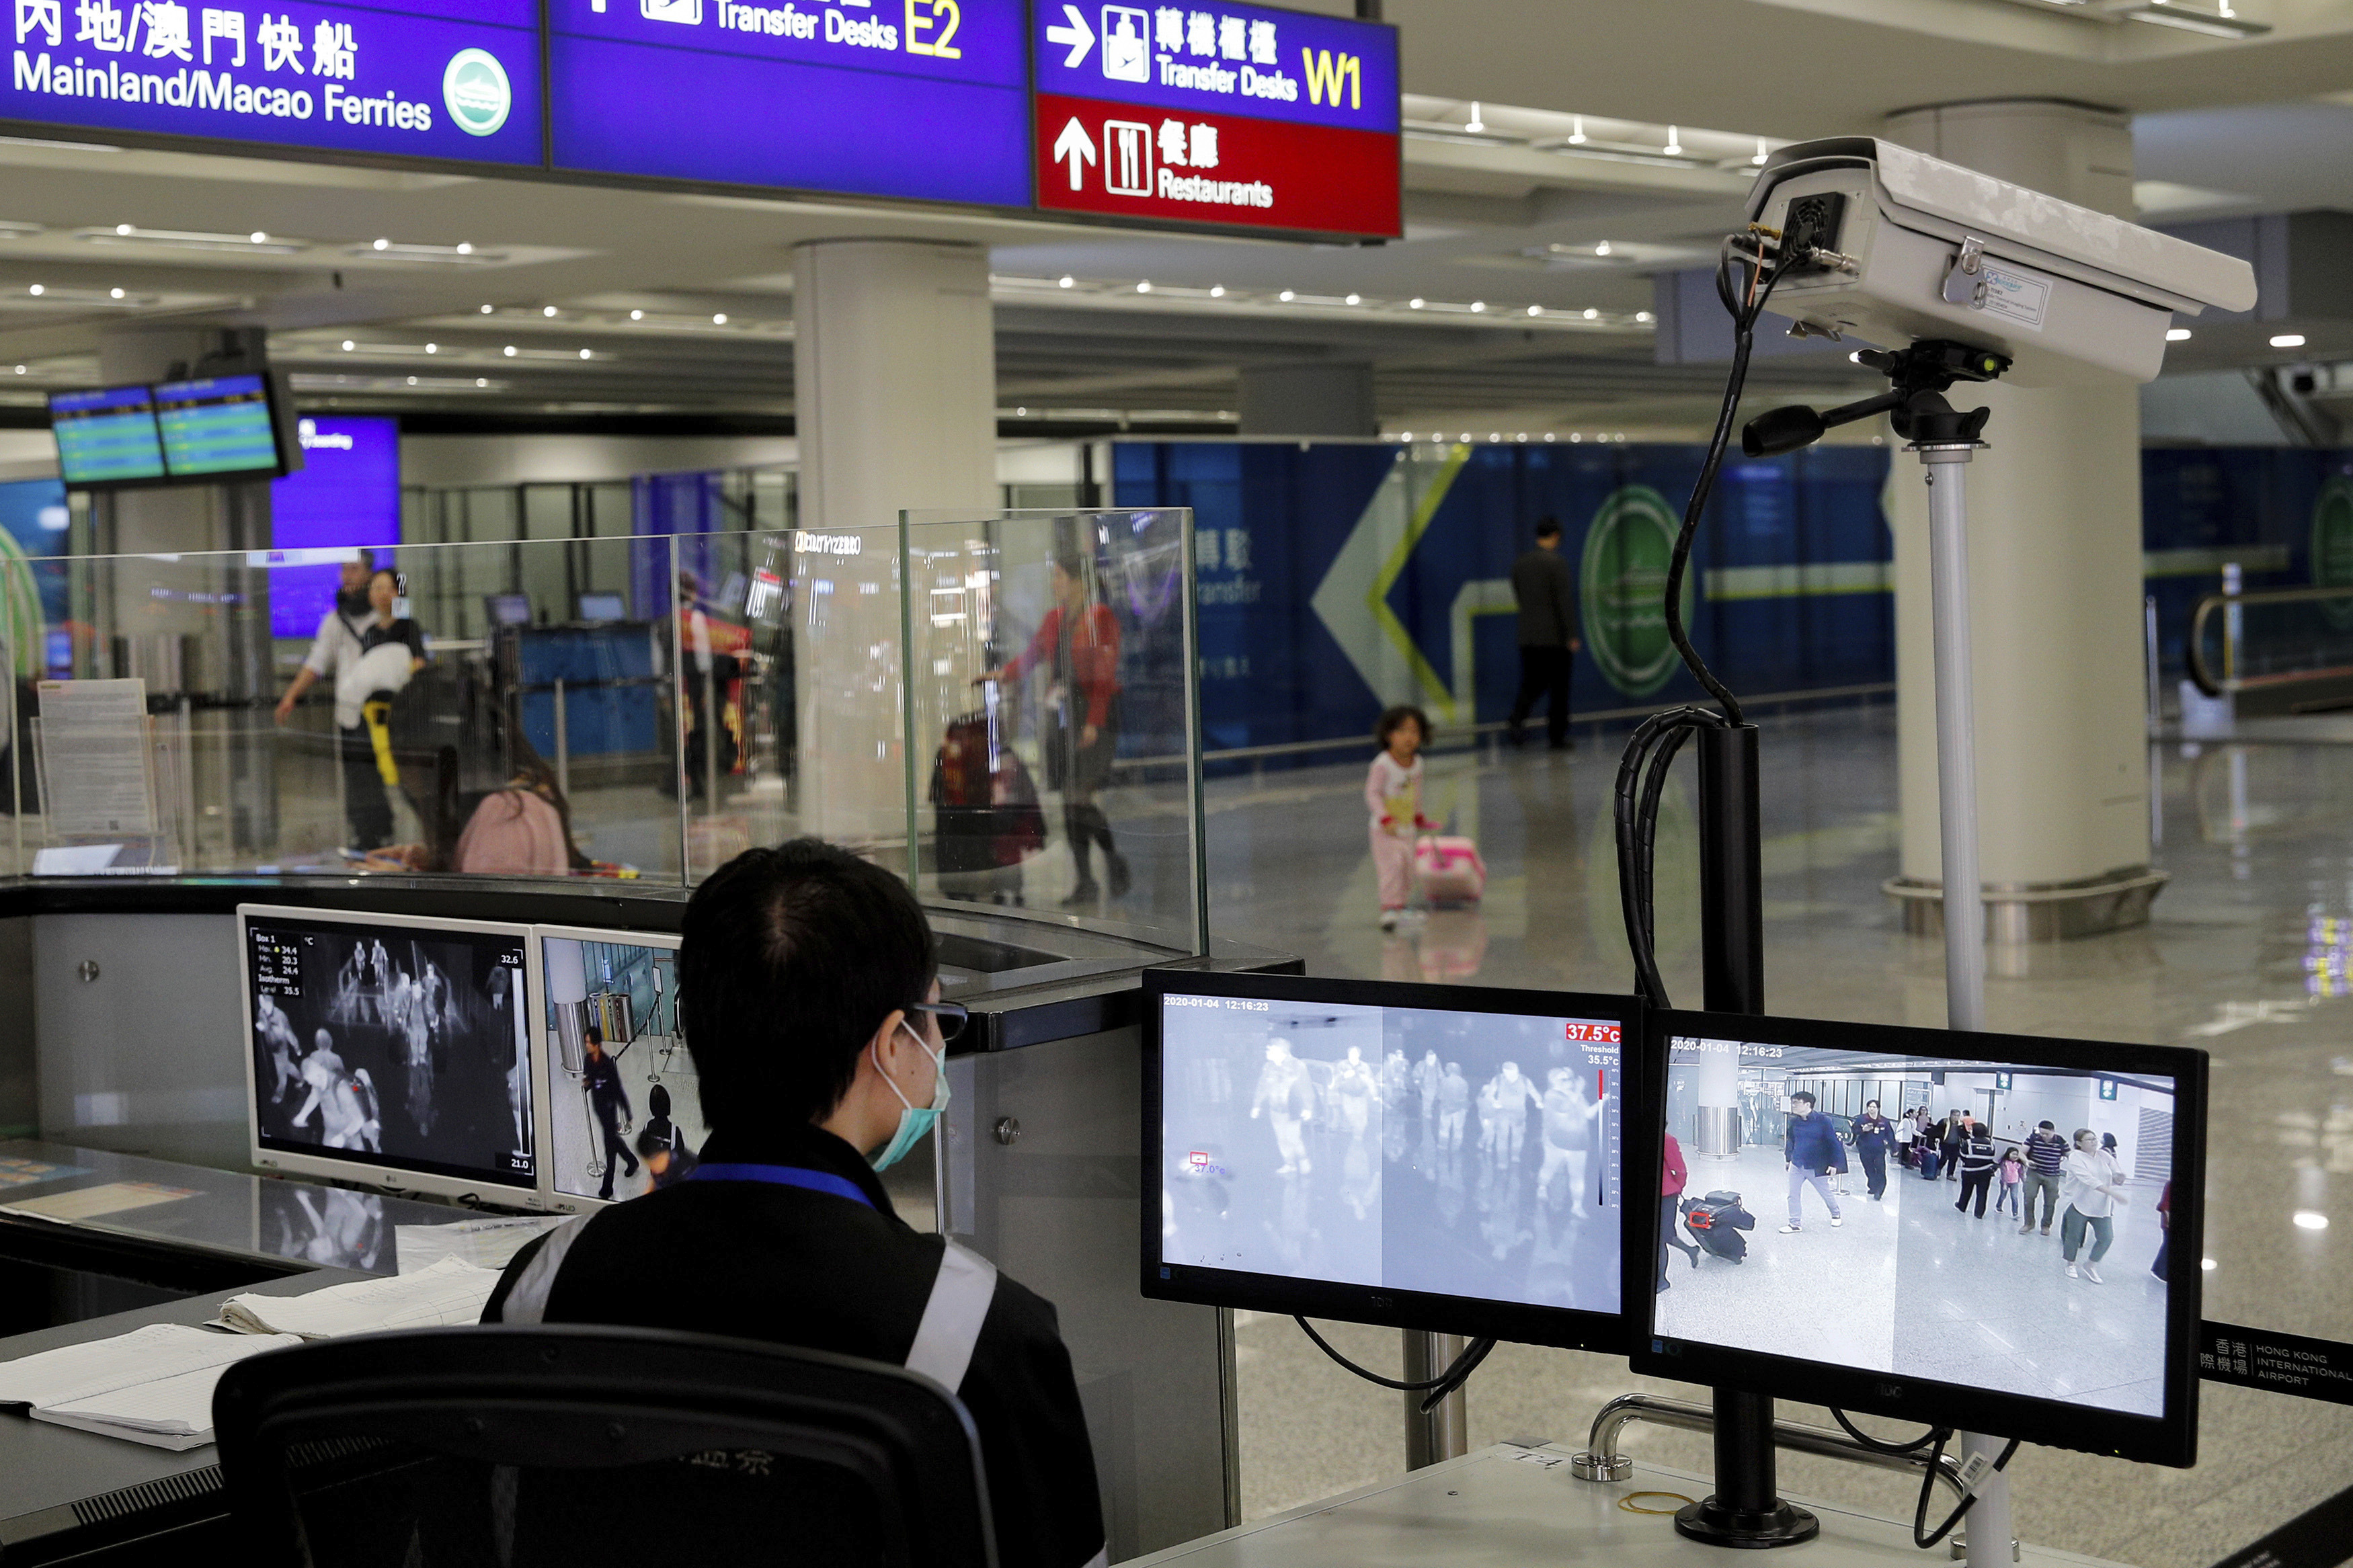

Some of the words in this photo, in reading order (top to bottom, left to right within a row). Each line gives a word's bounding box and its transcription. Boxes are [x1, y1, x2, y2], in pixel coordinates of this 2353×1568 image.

[713, 0, 820, 40] Transfer
[825, 8, 898, 51] Desks
[904, 0, 962, 59] E2
[1155, 54, 1237, 93] Transfer
[1240, 65, 1298, 102] Desks
[1302, 47, 1361, 110] W1
[13, 50, 314, 120] Mainland/Macao
[324, 83, 432, 132] Ferries
[1158, 167, 1274, 208] Restaurants
[501, 954, 518, 964] 32.6
[1164, 996, 1220, 1009] 2020-01-04
[1225, 1000, 1269, 1012] 12:16:23
[1580, 1044, 1620, 1055] Threshold
[1671, 1040, 1730, 1054] 2020-01-04
[1736, 1045, 1783, 1058] 12:16:23
[511, 1158, 528, 1169] 21.0
[2215, 1338, 2247, 1358] 香港
[2256, 1344, 2290, 1358] HONG
[2293, 1350, 2328, 1364] KONG
[2200, 1352, 2248, 1376] 際機場
[2257, 1357, 2353, 1381] INTERNATIONAL
[2258, 1370, 2310, 1386] AIRPORT
